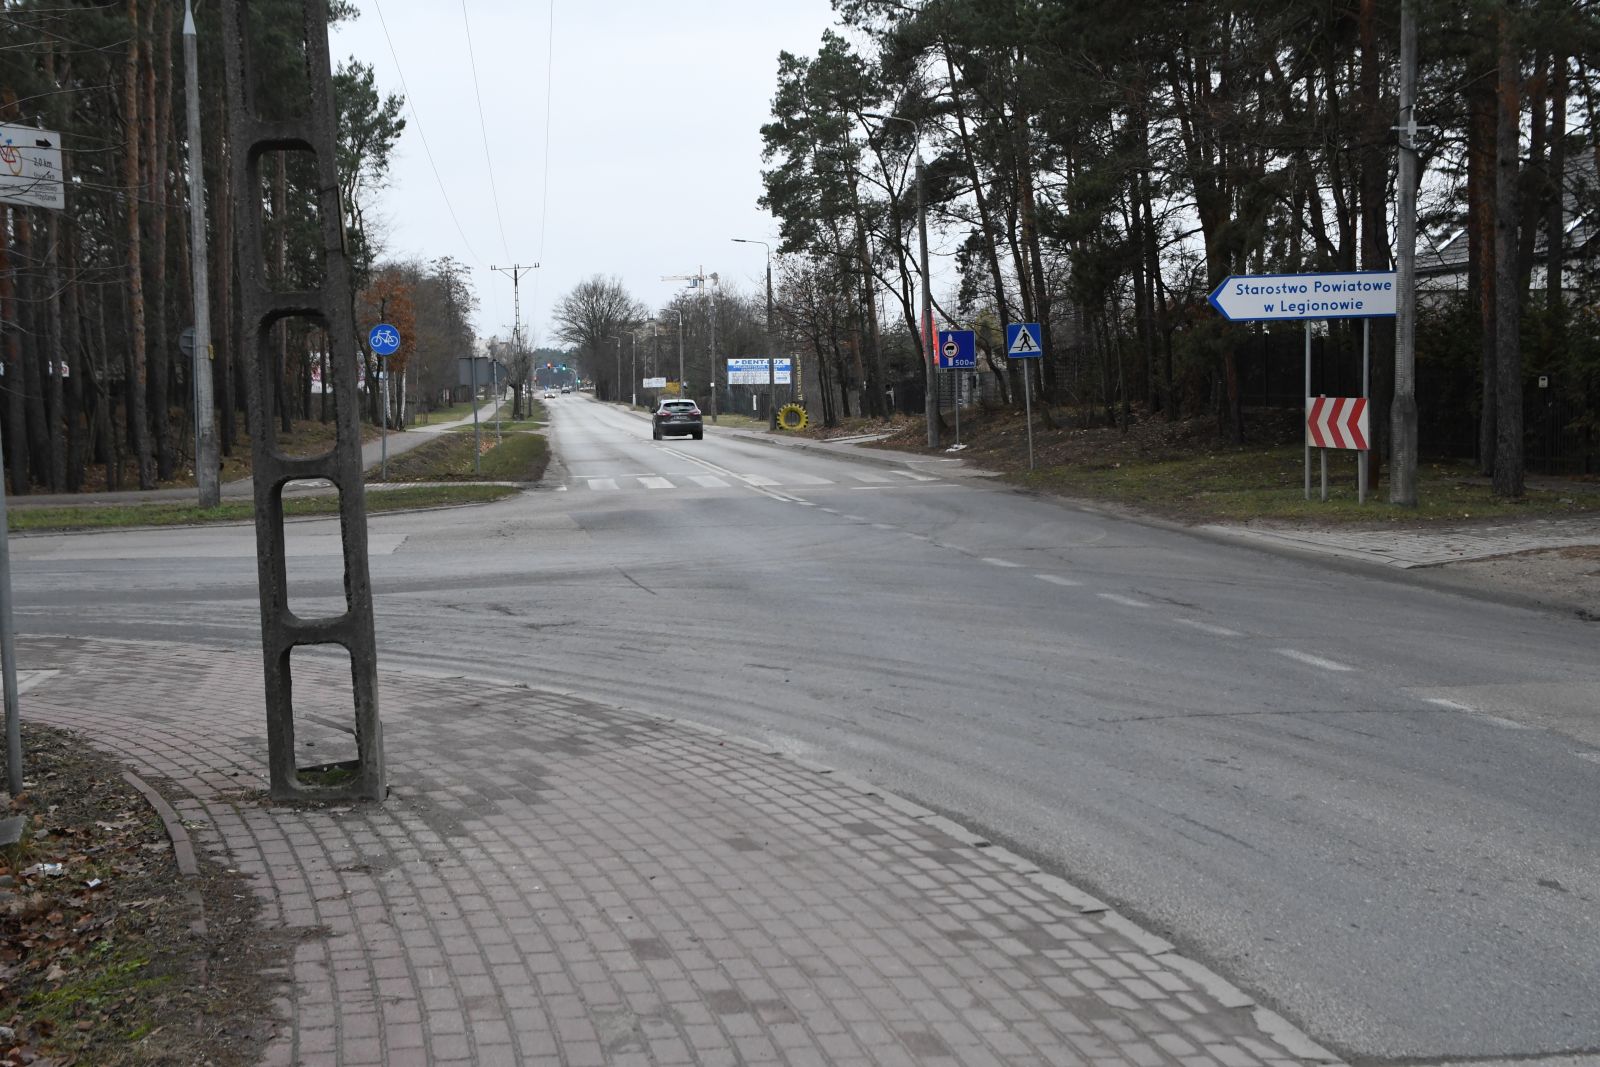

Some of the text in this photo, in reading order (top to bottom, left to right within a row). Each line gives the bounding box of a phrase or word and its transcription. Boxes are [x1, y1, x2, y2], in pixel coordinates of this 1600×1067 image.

[43, 159, 53, 169] km
[1236, 280, 1393, 296] Starostwo Powiatowe
[1264, 298, 1364, 315] w Legionowie
